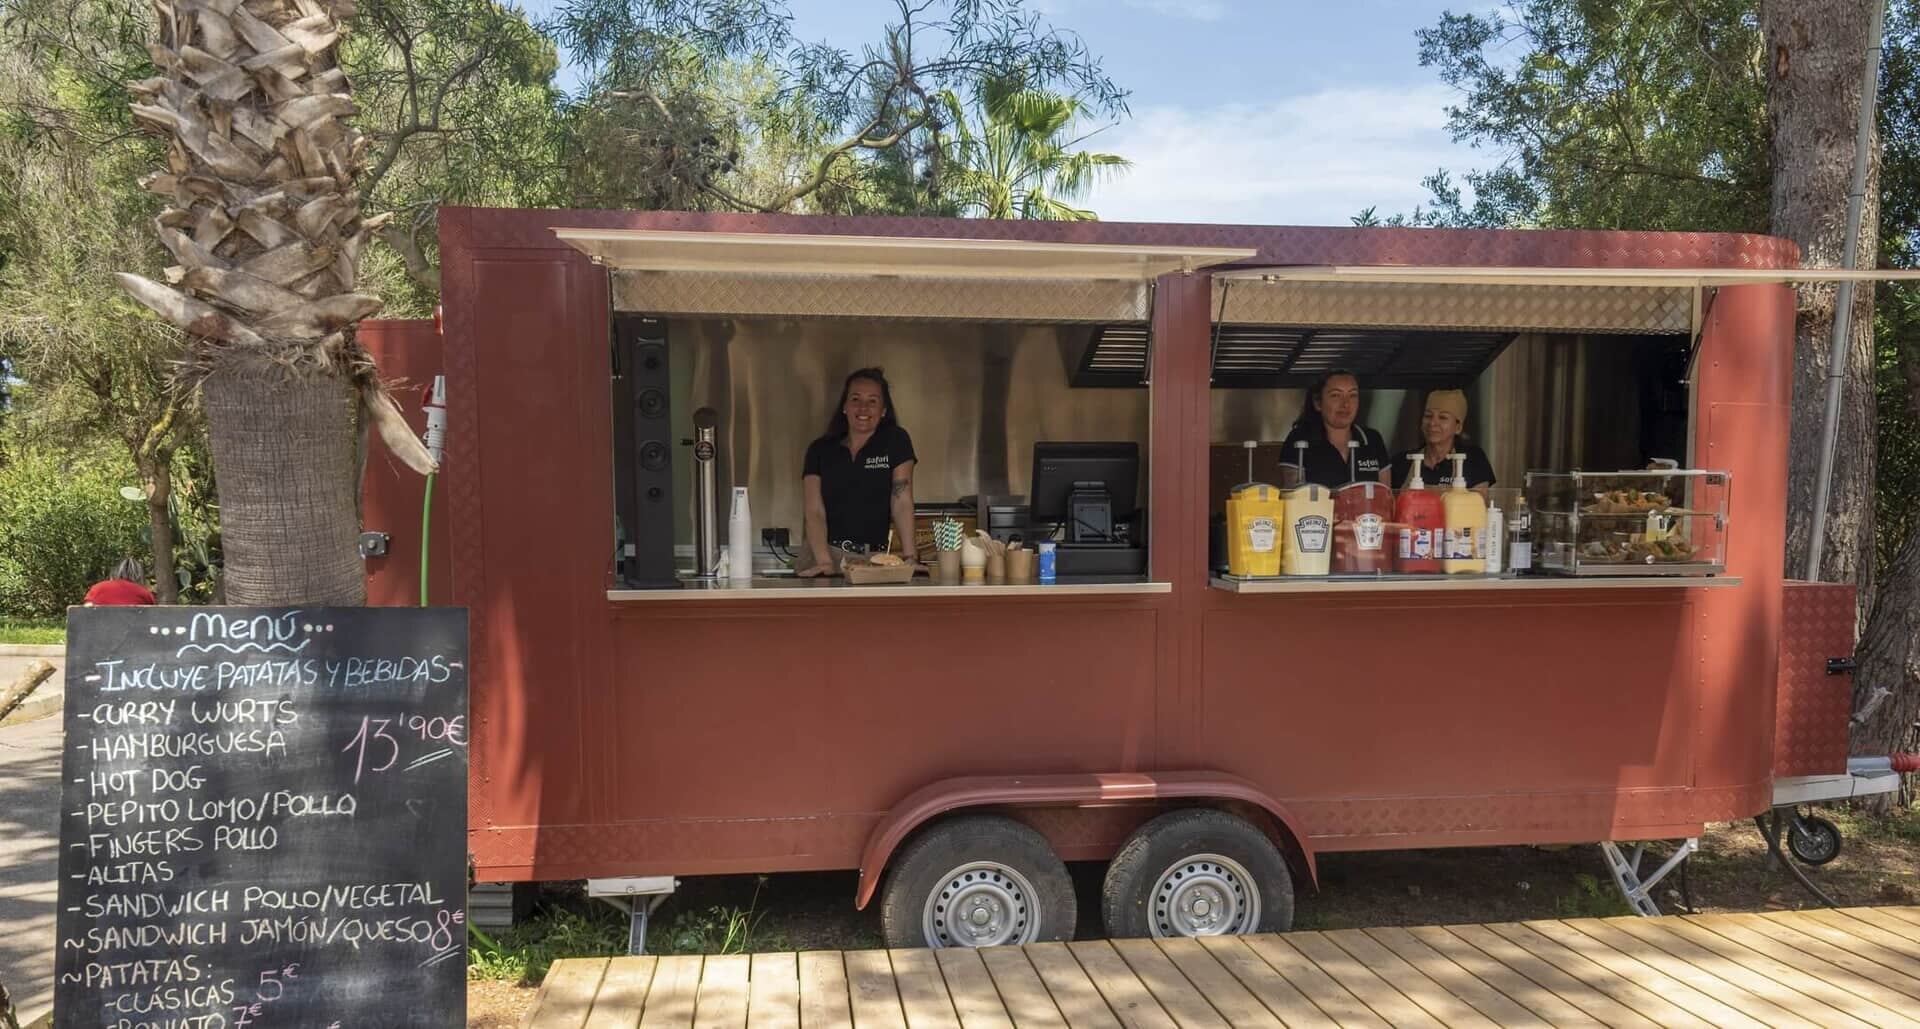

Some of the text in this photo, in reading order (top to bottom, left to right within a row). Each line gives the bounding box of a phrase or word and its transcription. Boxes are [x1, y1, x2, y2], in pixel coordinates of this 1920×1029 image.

[217, 659, 318, 690] PATATAS
[326, 661, 341, 688] Y
[192, 697, 299, 724] WURTS
[152, 766, 207, 793] DOG
[214, 825, 278, 852] POLLO
